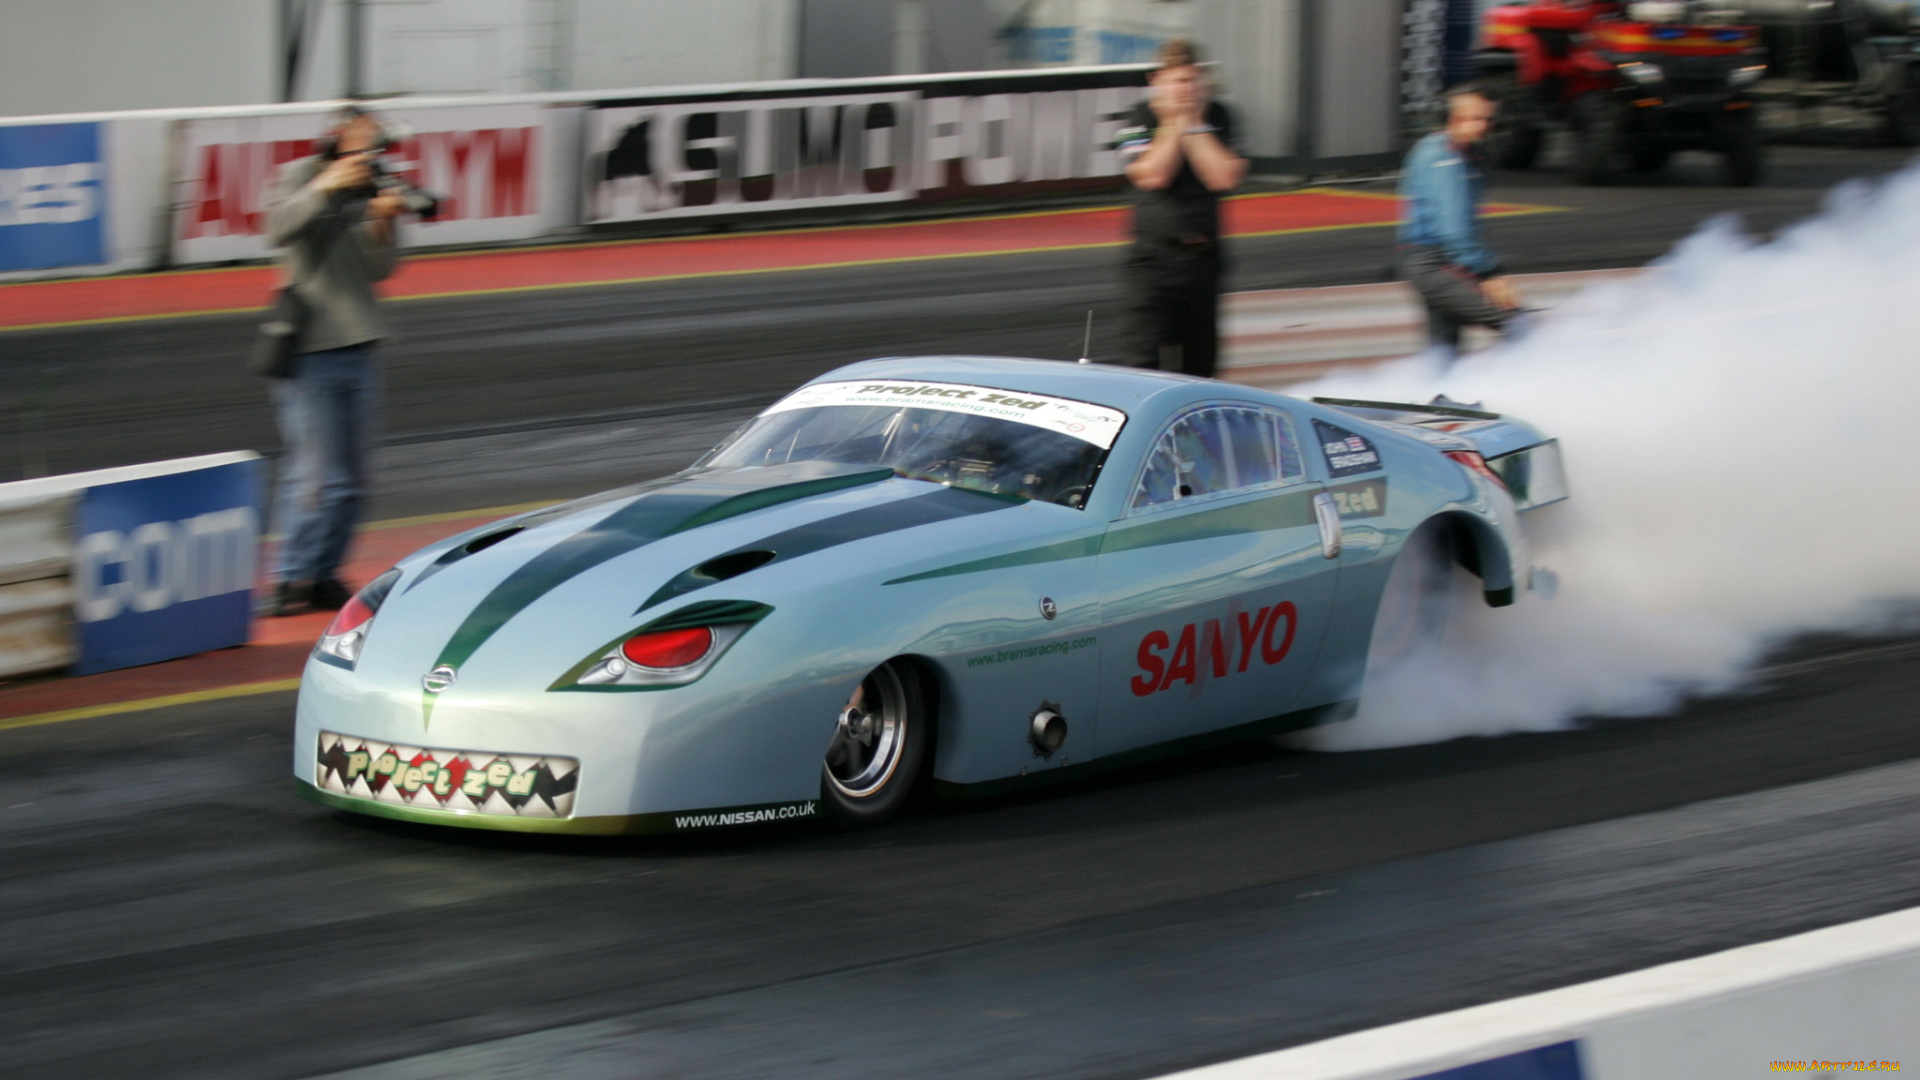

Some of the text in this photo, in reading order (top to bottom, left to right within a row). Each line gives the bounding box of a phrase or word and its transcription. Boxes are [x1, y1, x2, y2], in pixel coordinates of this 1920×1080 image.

[845, 396, 1027, 419] www.bramsracing.com
[966, 635, 1097, 668] www.bramsracing.com
[1130, 600, 1298, 698] SANYO
